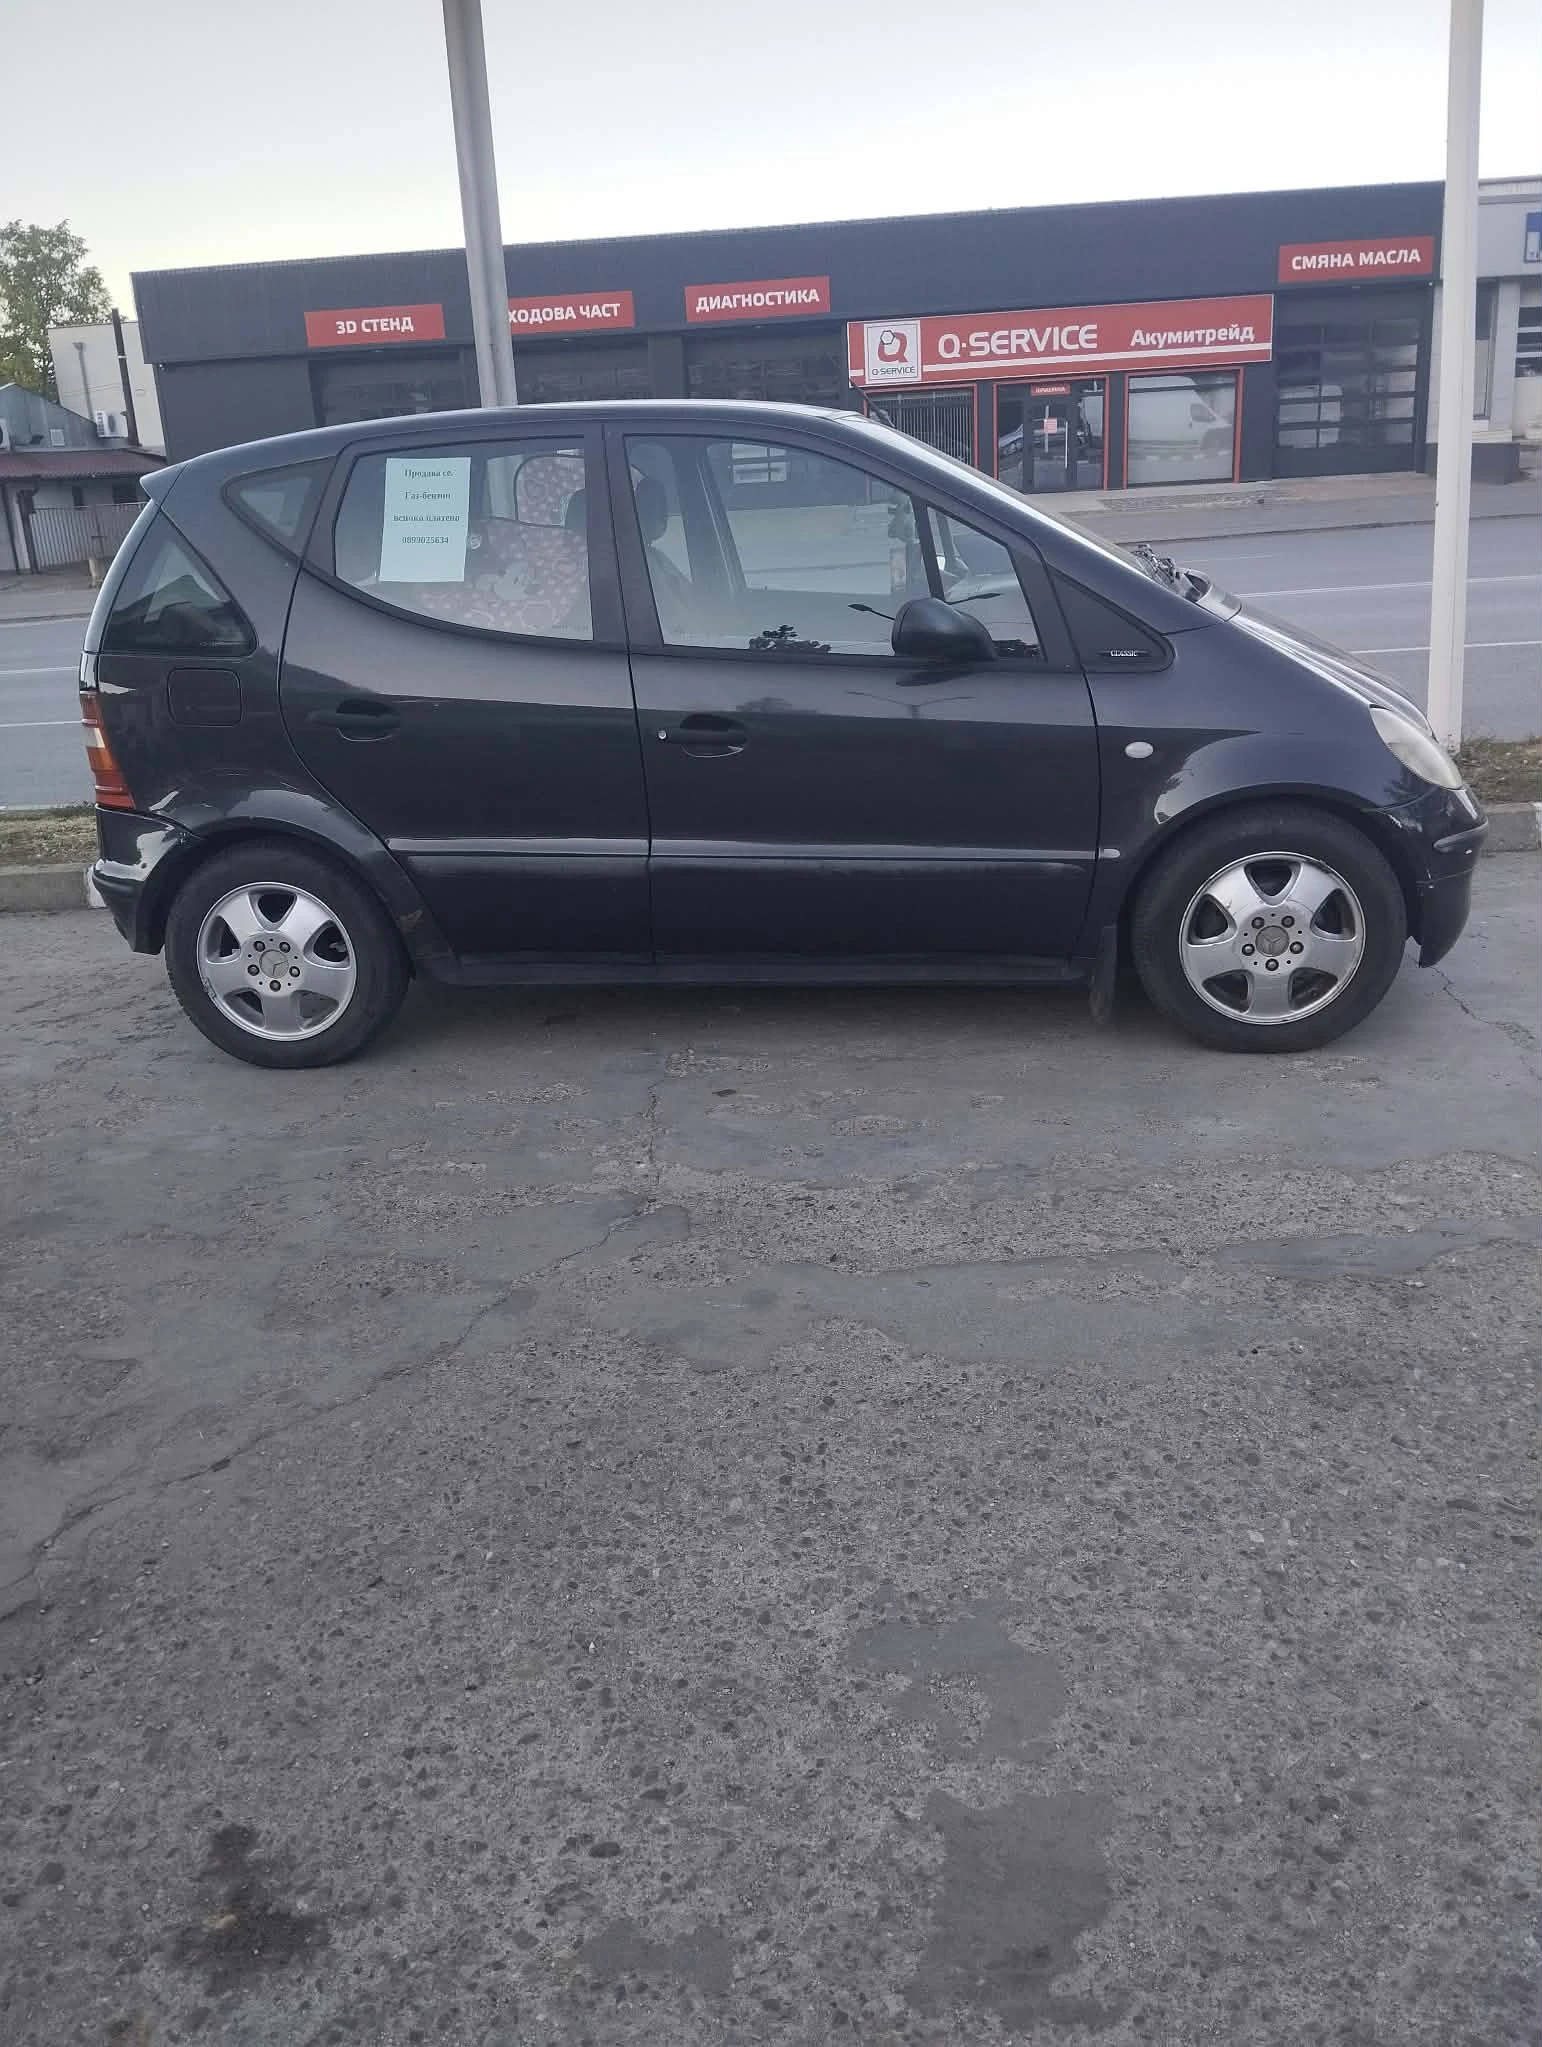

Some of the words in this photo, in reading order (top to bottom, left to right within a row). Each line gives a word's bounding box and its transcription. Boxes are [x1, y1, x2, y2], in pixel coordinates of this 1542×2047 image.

[1291, 252, 1355, 271] СМЯНА
[1359, 248, 1422, 266] МАСЛА
[579, 303, 621, 318] ЧАСТ
[695, 288, 820, 313] ДИАГНОСТИКА
[335, 320, 357, 335] 3D
[361, 316, 415, 333] СТЕНД
[1130, 322, 1255, 349] Акумитрейд
